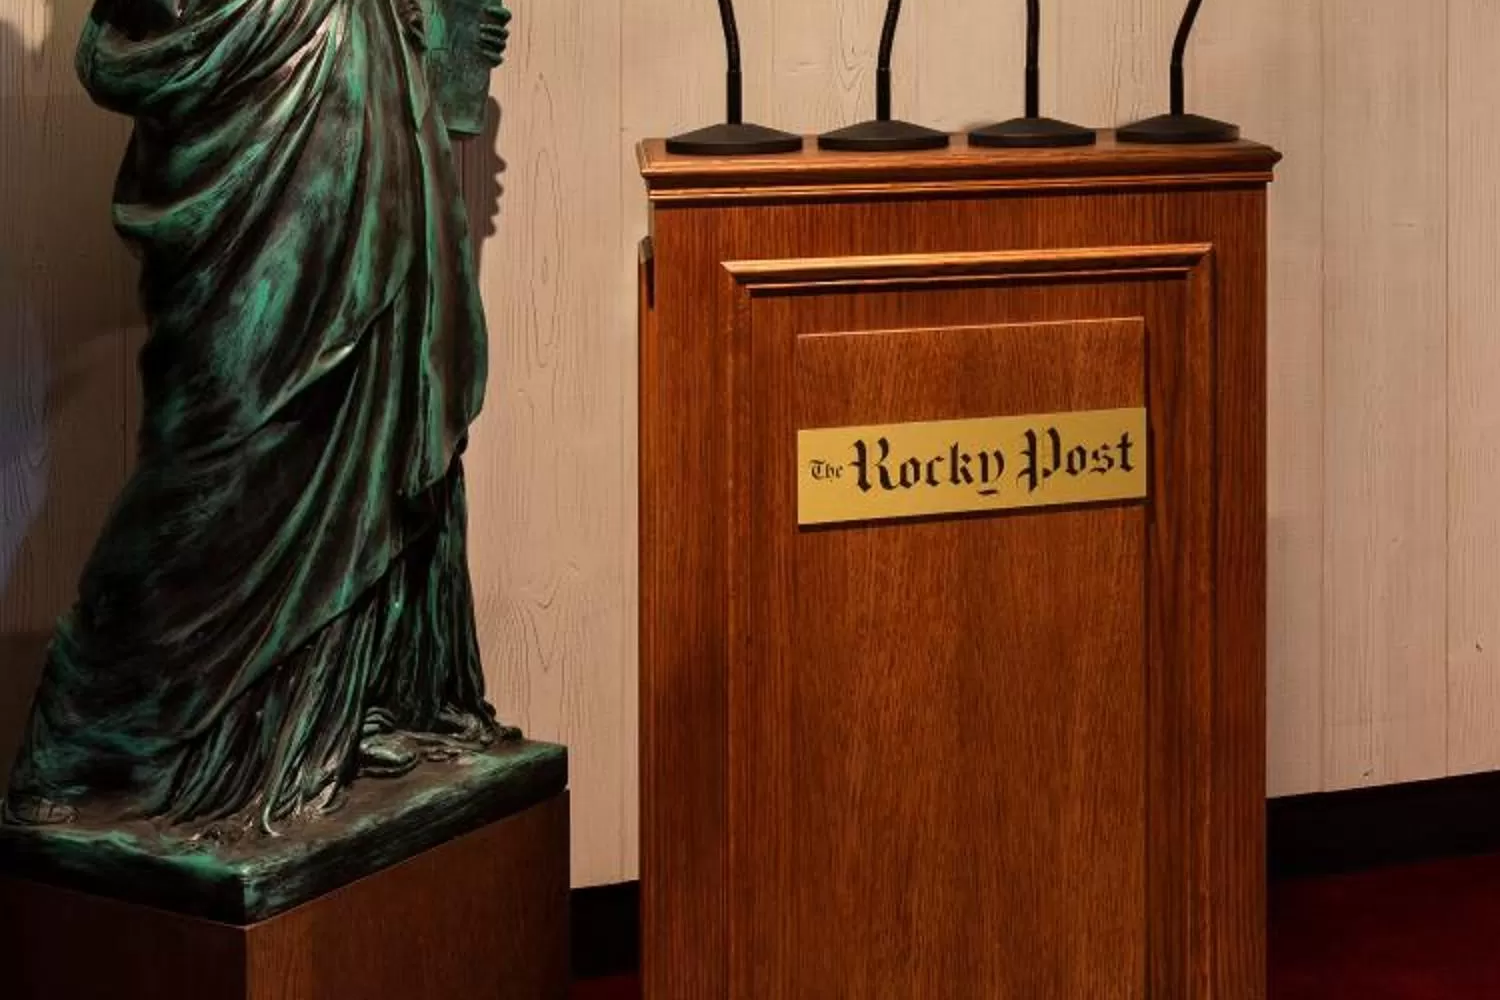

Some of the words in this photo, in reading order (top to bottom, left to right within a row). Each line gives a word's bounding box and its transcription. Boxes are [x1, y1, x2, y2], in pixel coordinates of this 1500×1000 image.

[810, 459, 843, 481] The
[848, 436, 1005, 495] Rocky
[1017, 427, 1135, 493] Post
